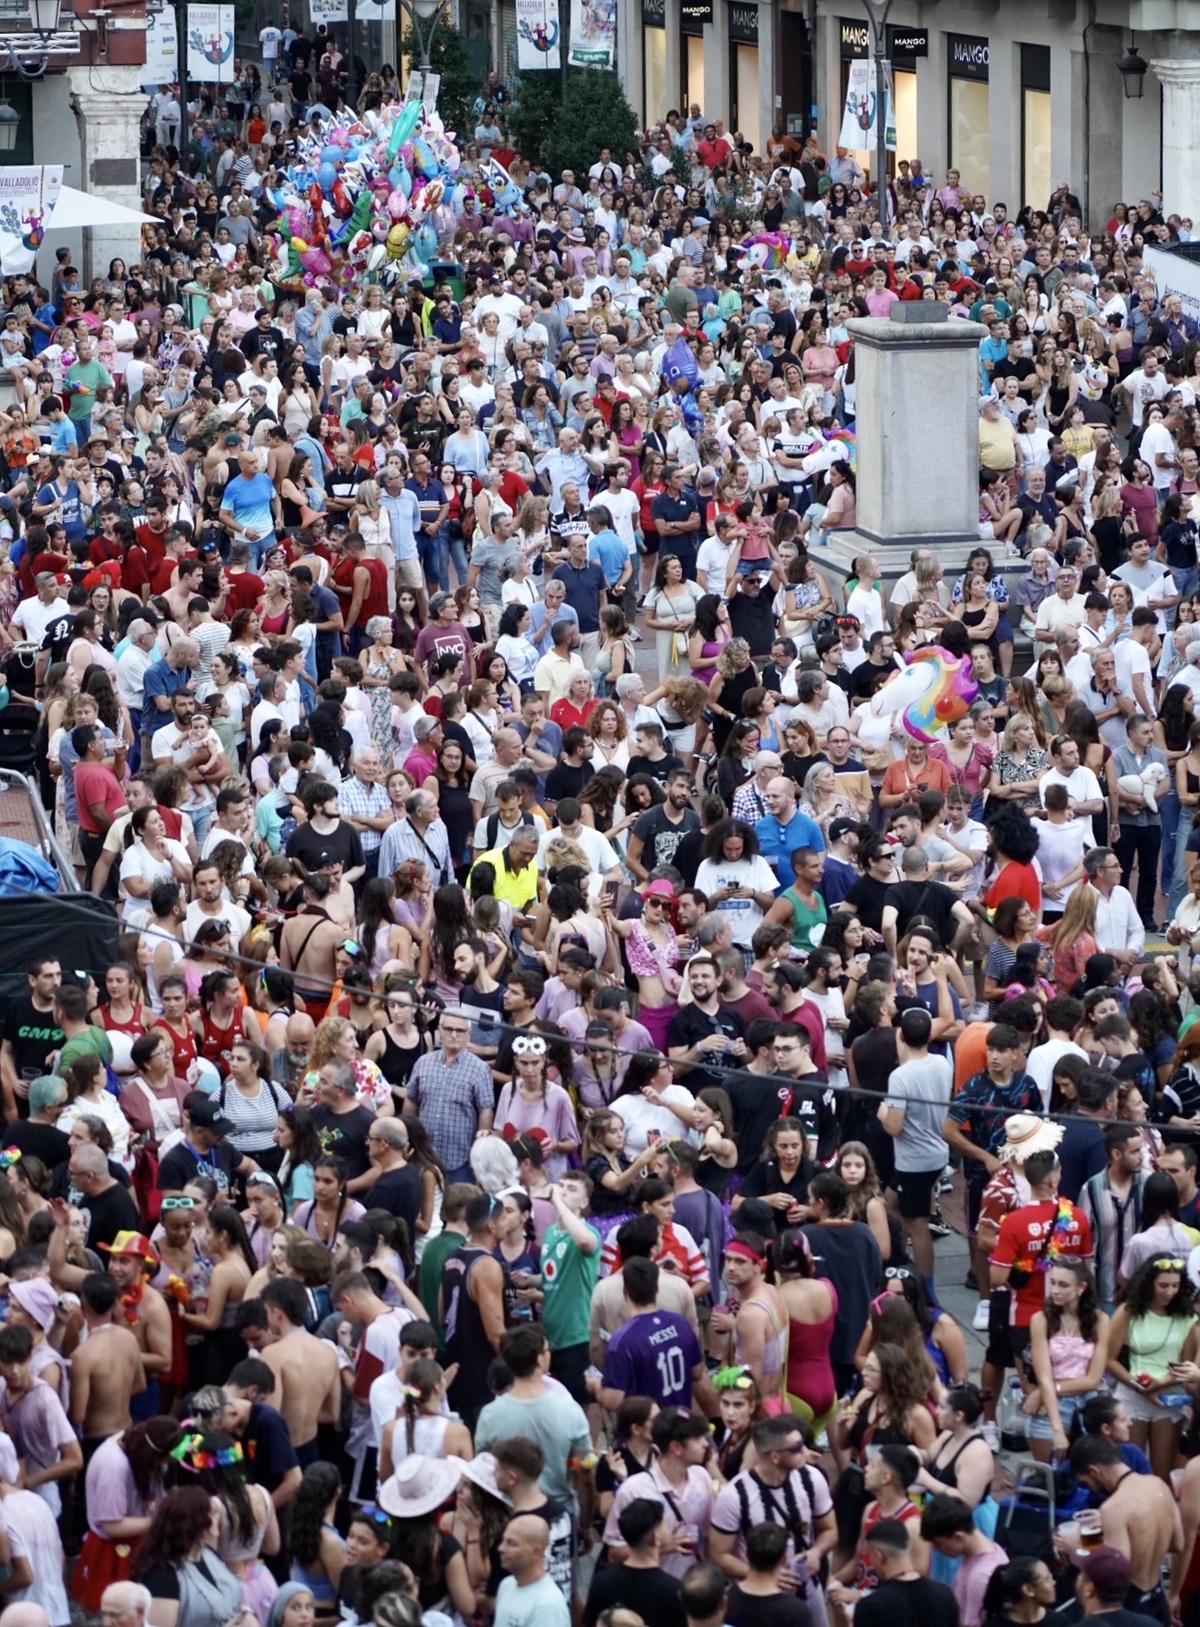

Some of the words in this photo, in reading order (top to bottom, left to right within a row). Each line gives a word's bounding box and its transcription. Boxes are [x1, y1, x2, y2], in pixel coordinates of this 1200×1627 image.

[894, 38, 925, 46] MANGO
[954, 43, 989, 65] MANGO
[0, 177, 39, 187] VALLADOLID
[25, 186, 38, 195] 2024
[439, 643, 464, 657] NYC
[648, 1325, 679, 1346] MESSI
[657, 1346, 685, 1397] 10
